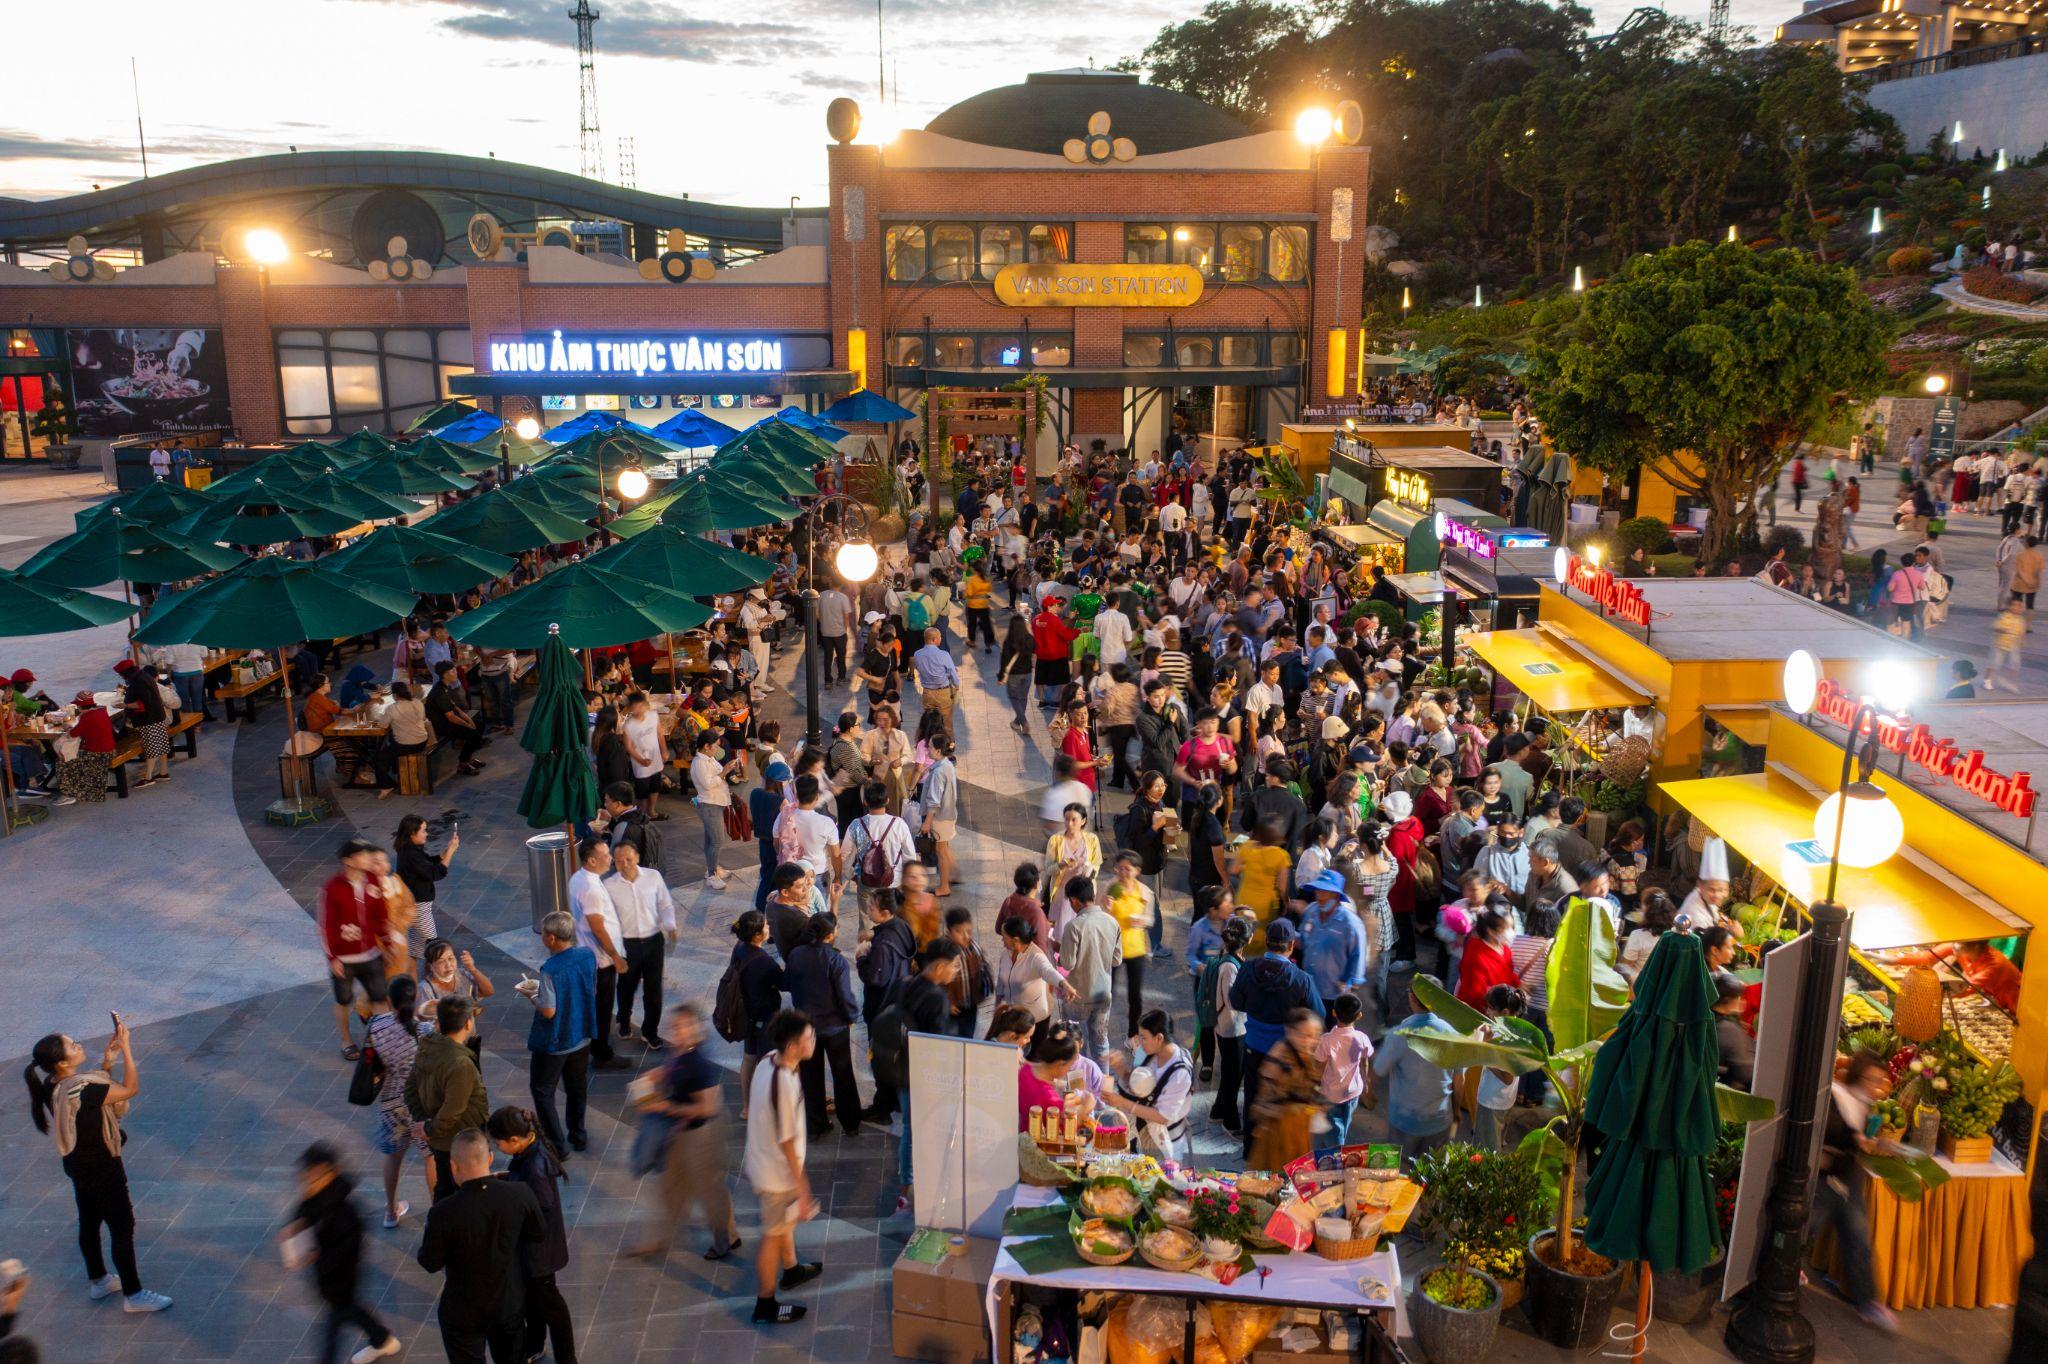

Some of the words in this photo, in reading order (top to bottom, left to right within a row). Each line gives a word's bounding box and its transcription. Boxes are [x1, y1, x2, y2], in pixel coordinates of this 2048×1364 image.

[1012, 276, 1050, 294] VAN
[1055, 276, 1095, 294] SON
[1101, 276, 1188, 294] STATION
[491, 342, 546, 372] KHU
[550, 330, 594, 372] ẨM
[597, 340, 667, 377] THỰC
[670, 335, 724, 371] VÂN
[727, 340, 783, 371] SƠN
[1951, 750, 2034, 819] danh
